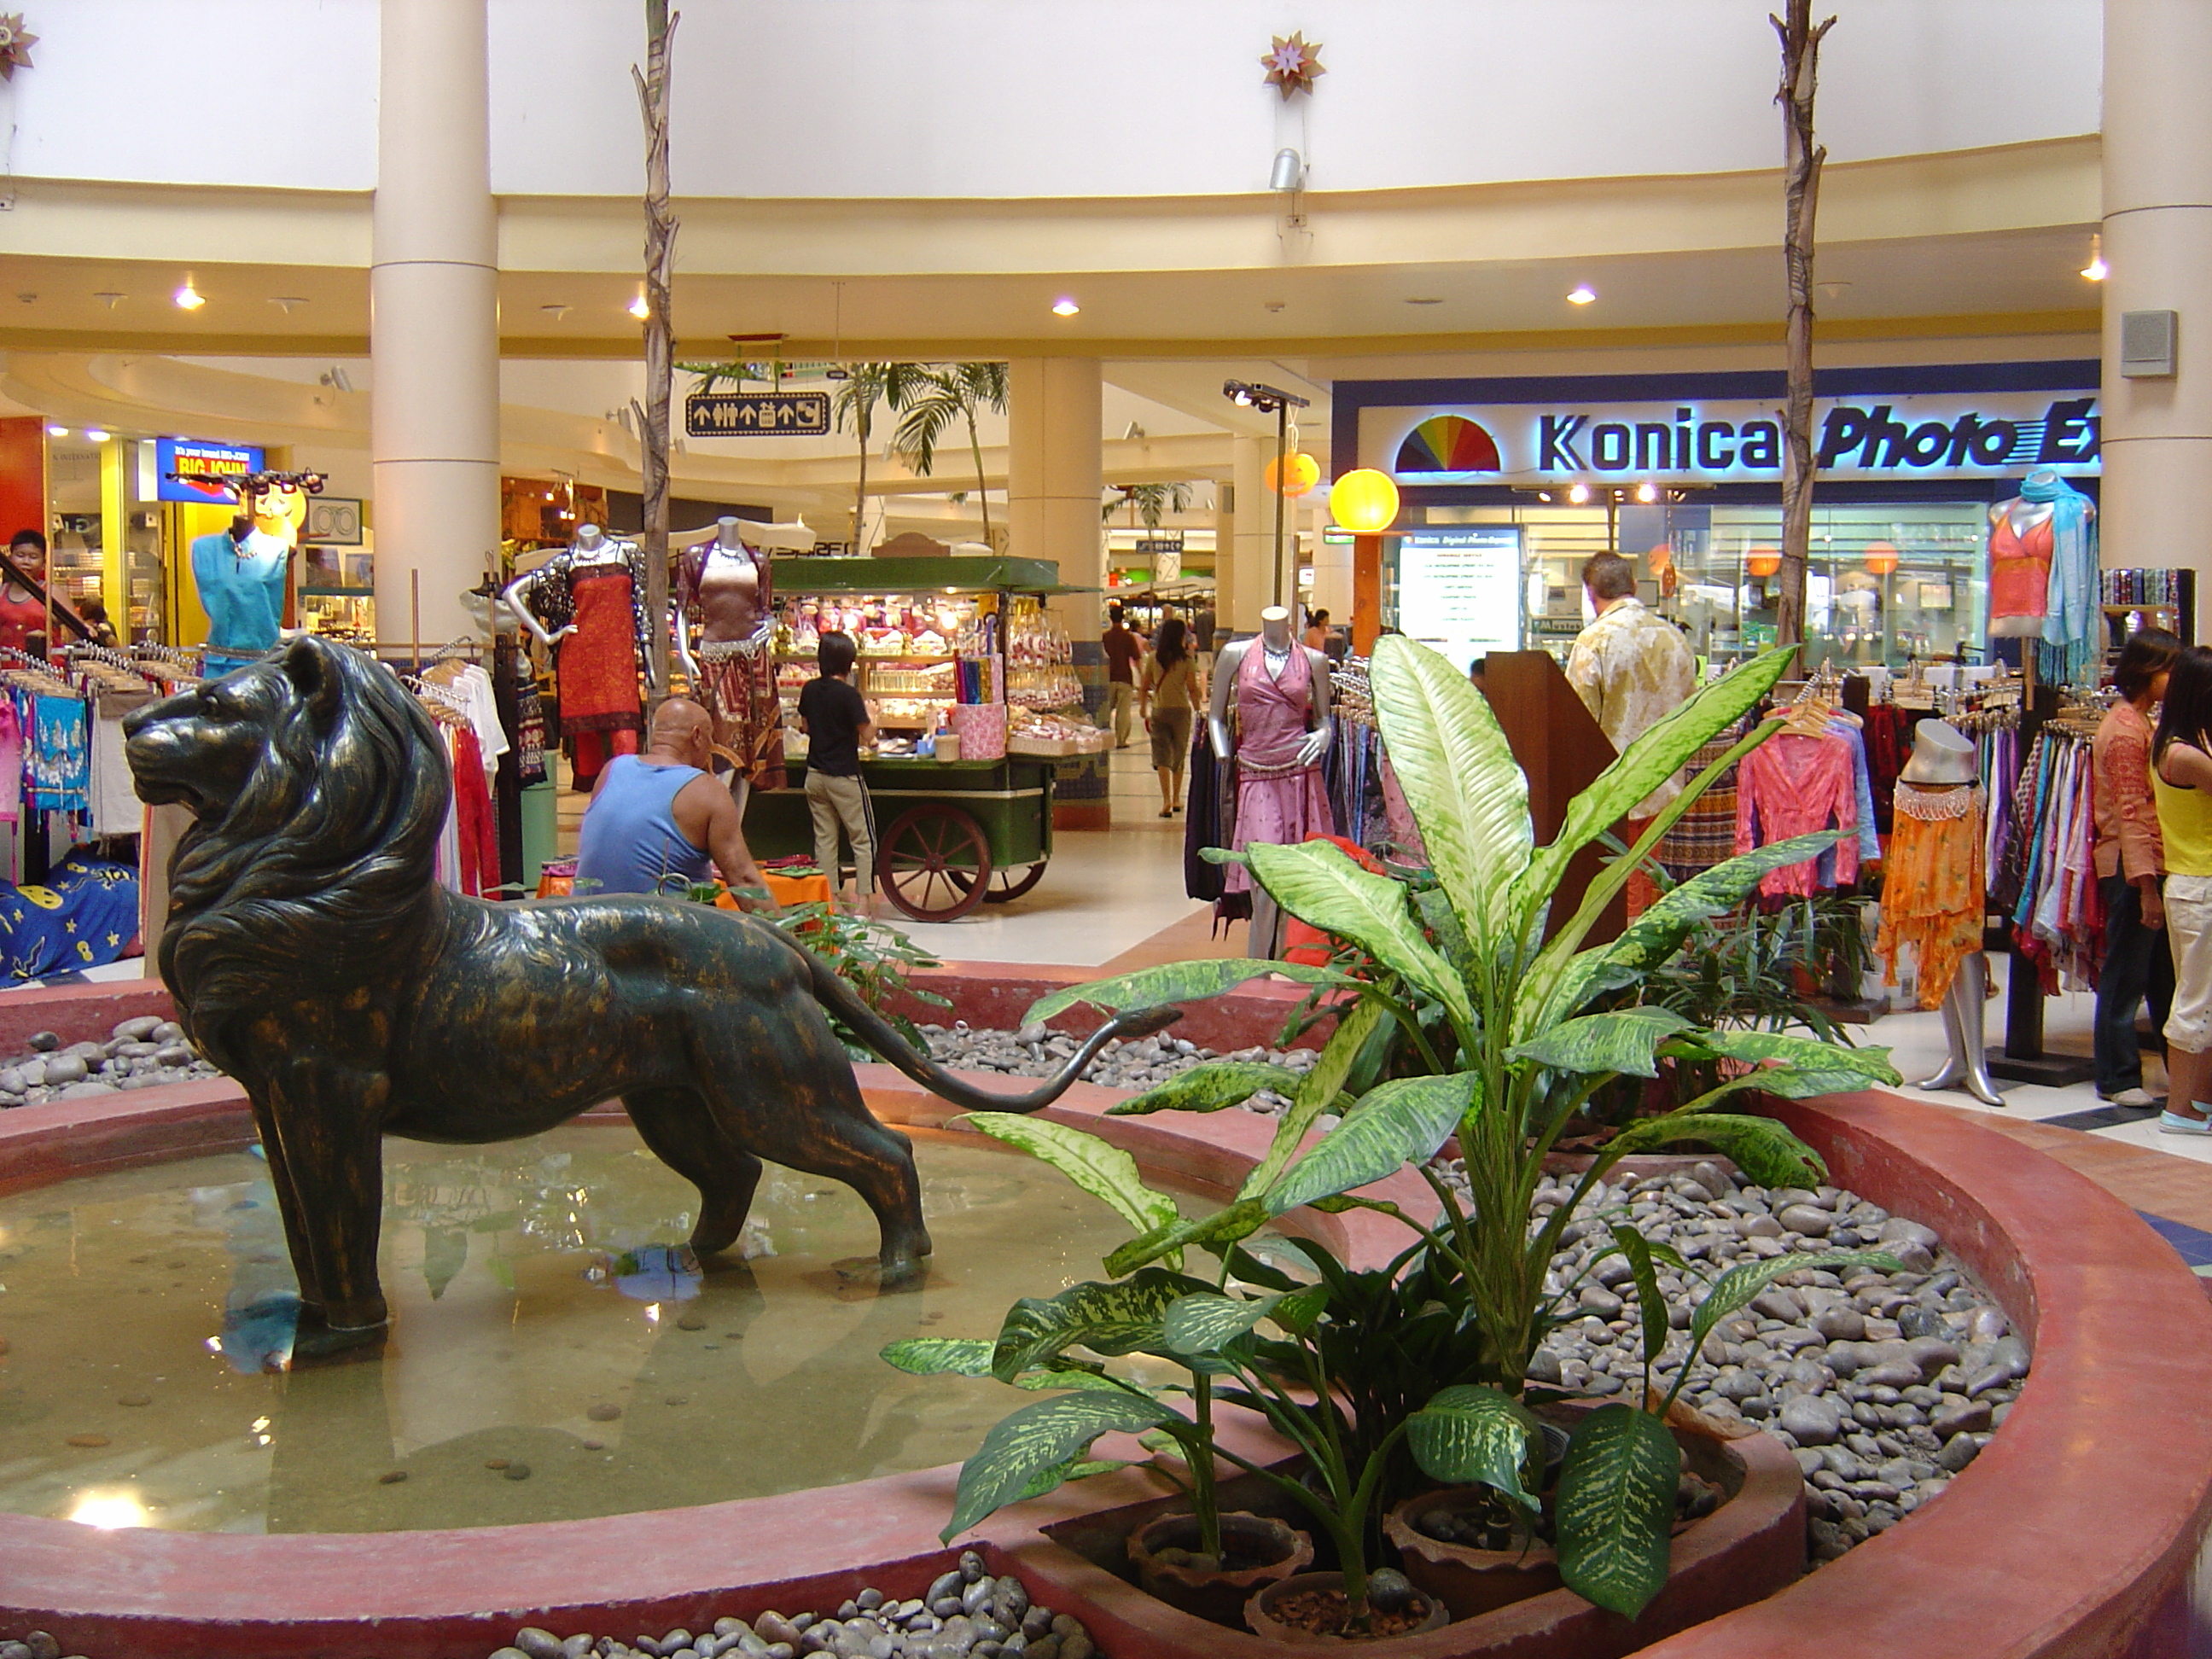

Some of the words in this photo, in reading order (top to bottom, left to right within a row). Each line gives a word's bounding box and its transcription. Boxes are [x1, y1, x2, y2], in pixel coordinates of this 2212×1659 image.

[1540, 407, 1780, 470] Konica
[1818, 405, 2017, 467] Photo
[178, 457, 206, 474] BIG
[211, 461, 246, 474] JOHN
